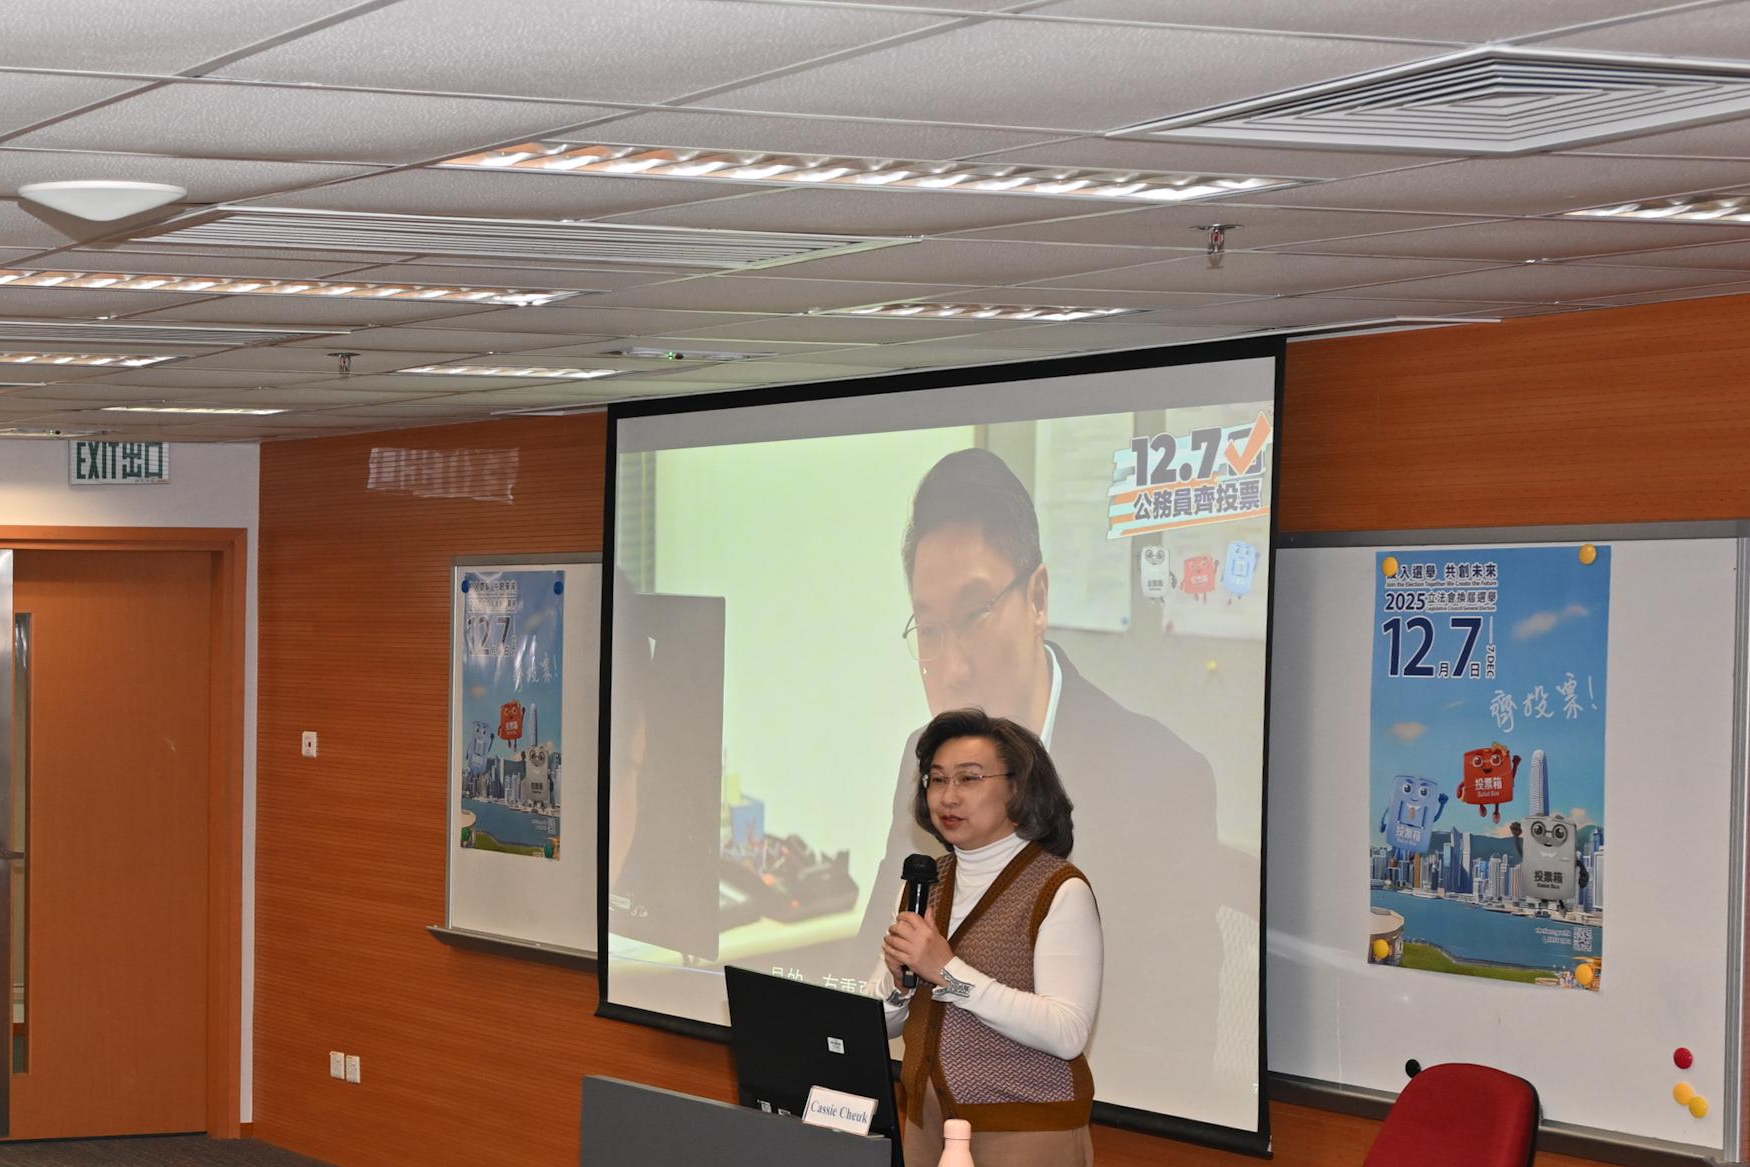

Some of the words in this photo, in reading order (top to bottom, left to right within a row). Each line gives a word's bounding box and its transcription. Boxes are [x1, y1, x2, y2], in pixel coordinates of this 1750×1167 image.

[77, 442, 120, 479] EXIT
[122, 442, 163, 479] 出口
[1131, 427, 1222, 487] 12.7
[1133, 479, 1261, 521] 公務員齊投票
[1387, 563, 1437, 579] 入選舉
[1444, 562, 1498, 578] 共創未來
[1385, 592, 1426, 611] 2025
[1486, 656, 1495, 678] DEC
[1534, 870, 1563, 884] 投票箱
[810, 1100, 838, 1118] Cassie
[839, 1105, 869, 1124] Cheuk
